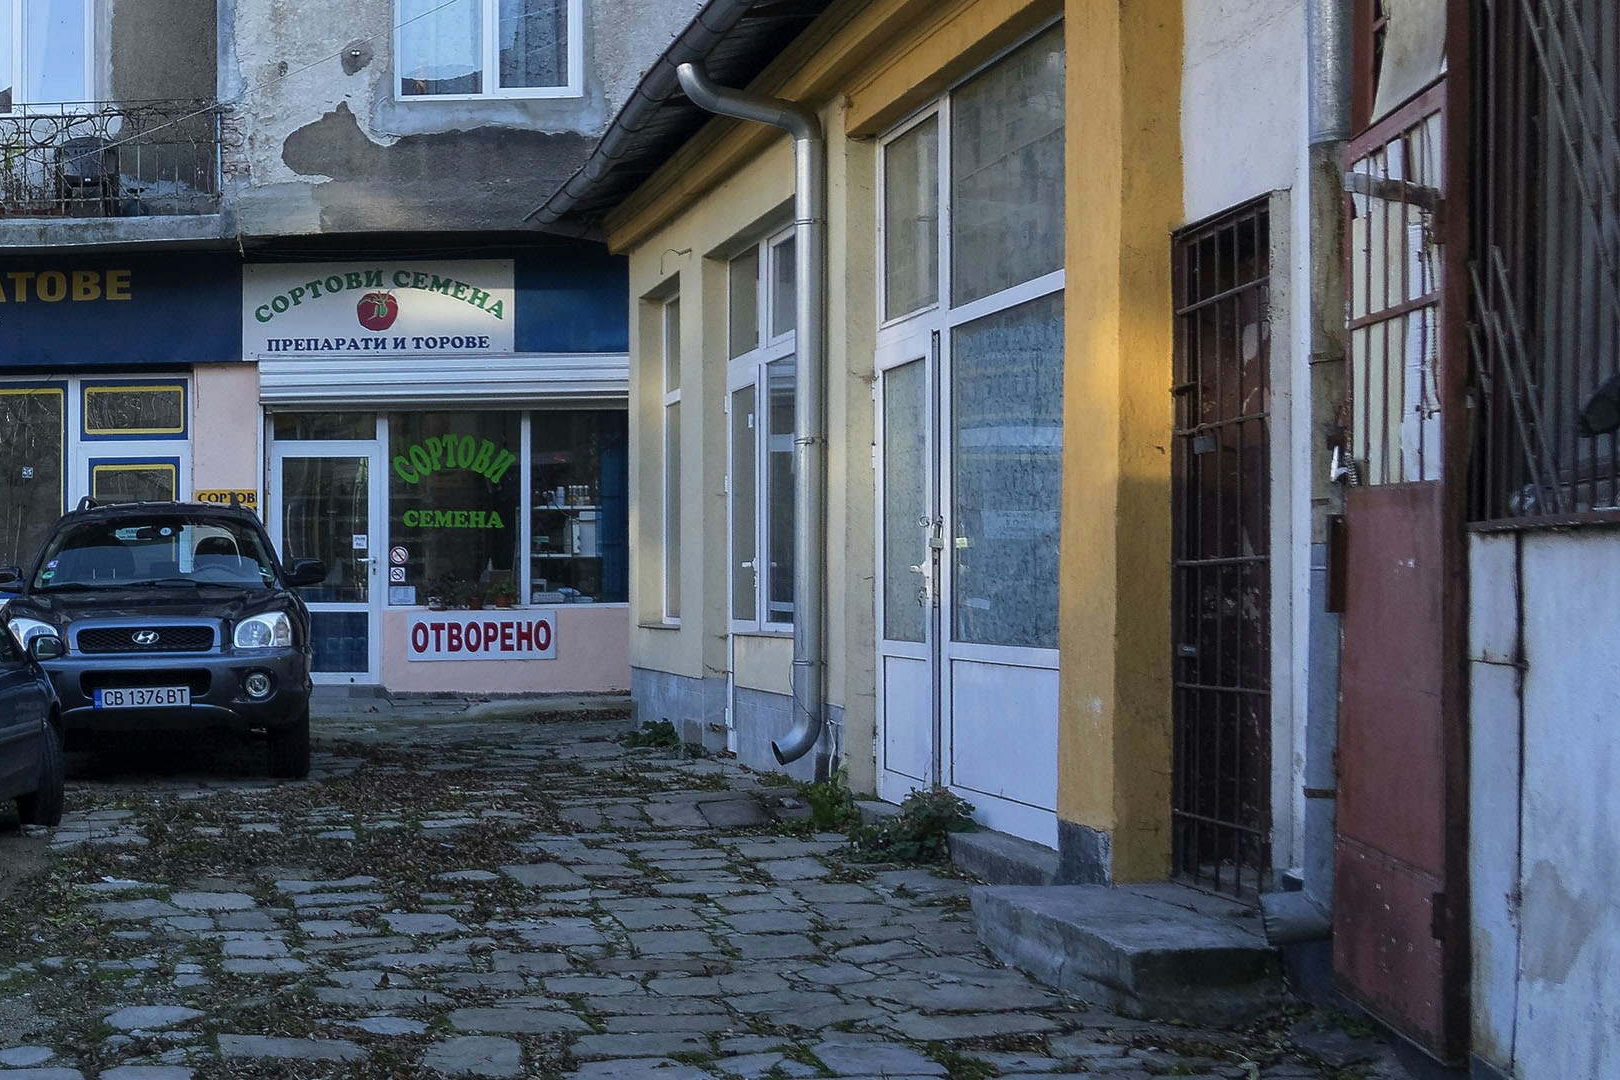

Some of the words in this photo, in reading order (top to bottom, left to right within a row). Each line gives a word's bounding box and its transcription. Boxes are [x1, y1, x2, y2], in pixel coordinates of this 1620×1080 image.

[254, 270, 384, 323] СОРТОВИ
[392, 270, 504, 320] СЕМЕНА
[267, 336, 387, 352] ПРЕПАРАТИ
[393, 336, 406, 349] И
[412, 335, 490, 349] ТОРОВЕ
[393, 433, 517, 484] СОРТОВИ
[402, 510, 504, 528] СЕМЕНА
[411, 619, 552, 653] ОТВОРЕНО
